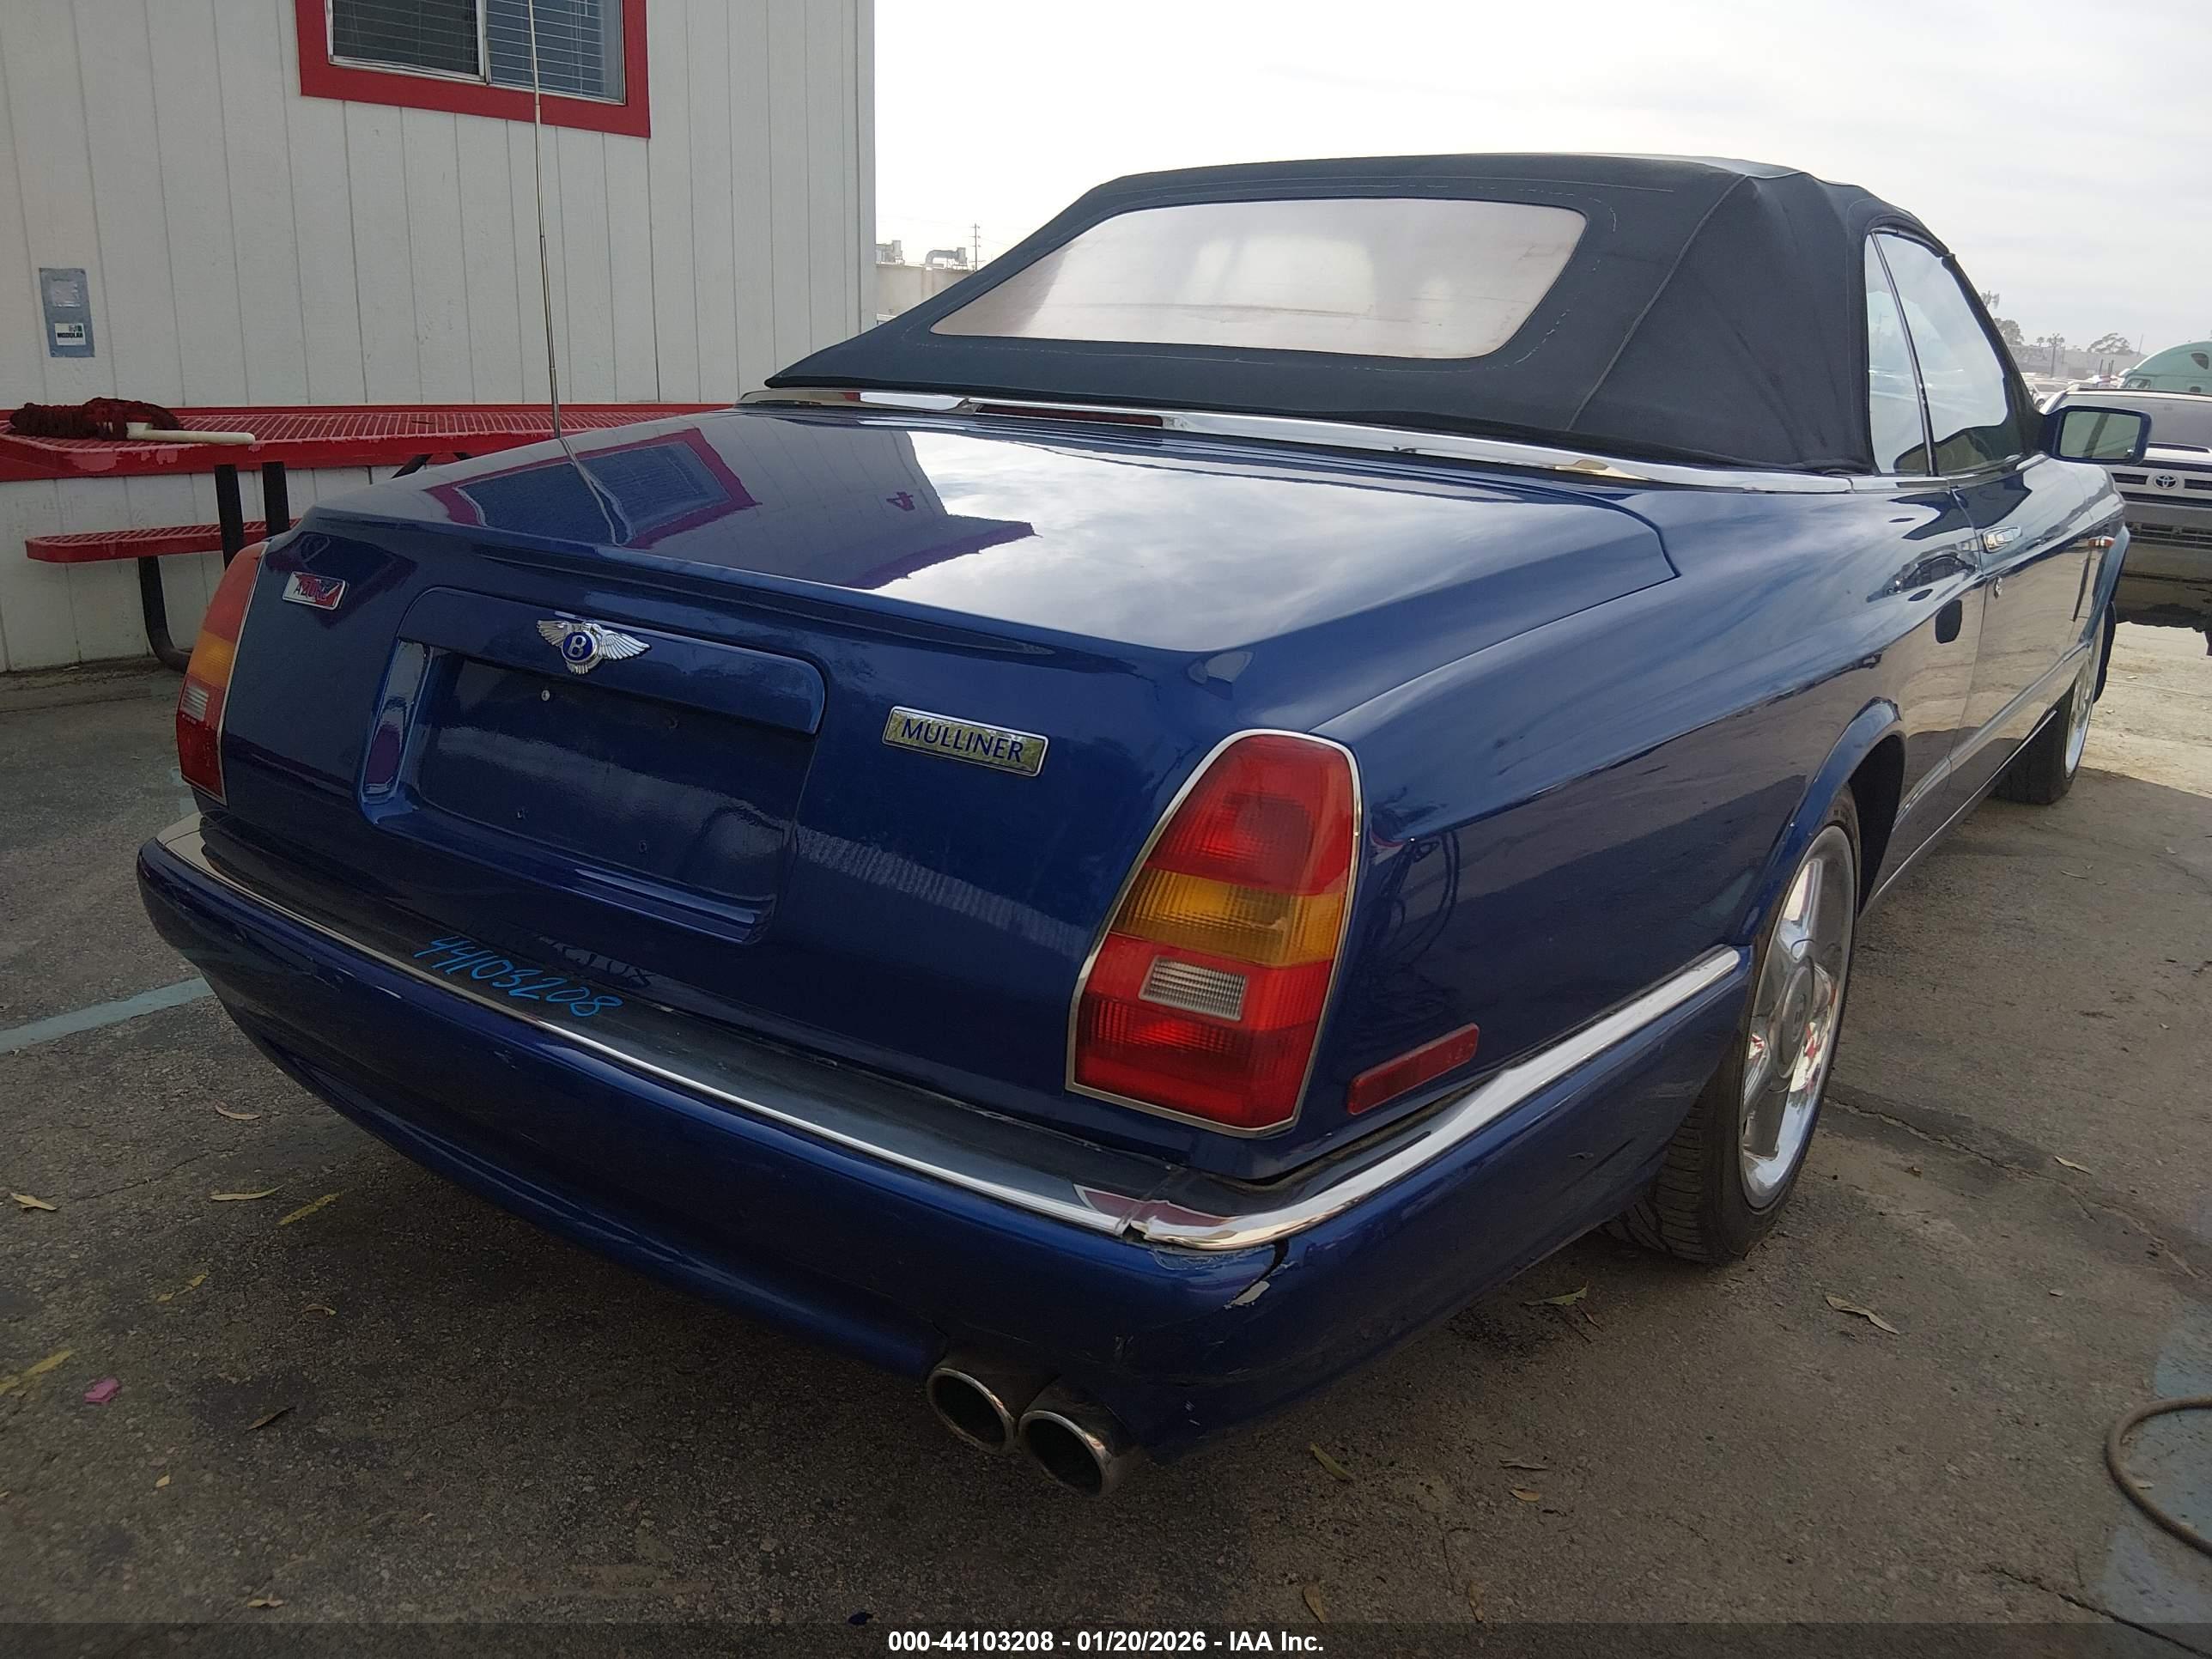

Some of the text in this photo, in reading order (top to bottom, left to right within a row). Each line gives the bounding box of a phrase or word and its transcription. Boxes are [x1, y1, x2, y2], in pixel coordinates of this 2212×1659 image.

[567, 635, 587, 658] B
[901, 718, 1024, 763] MULLINER
[413, 935, 624, 1017] 44103208
